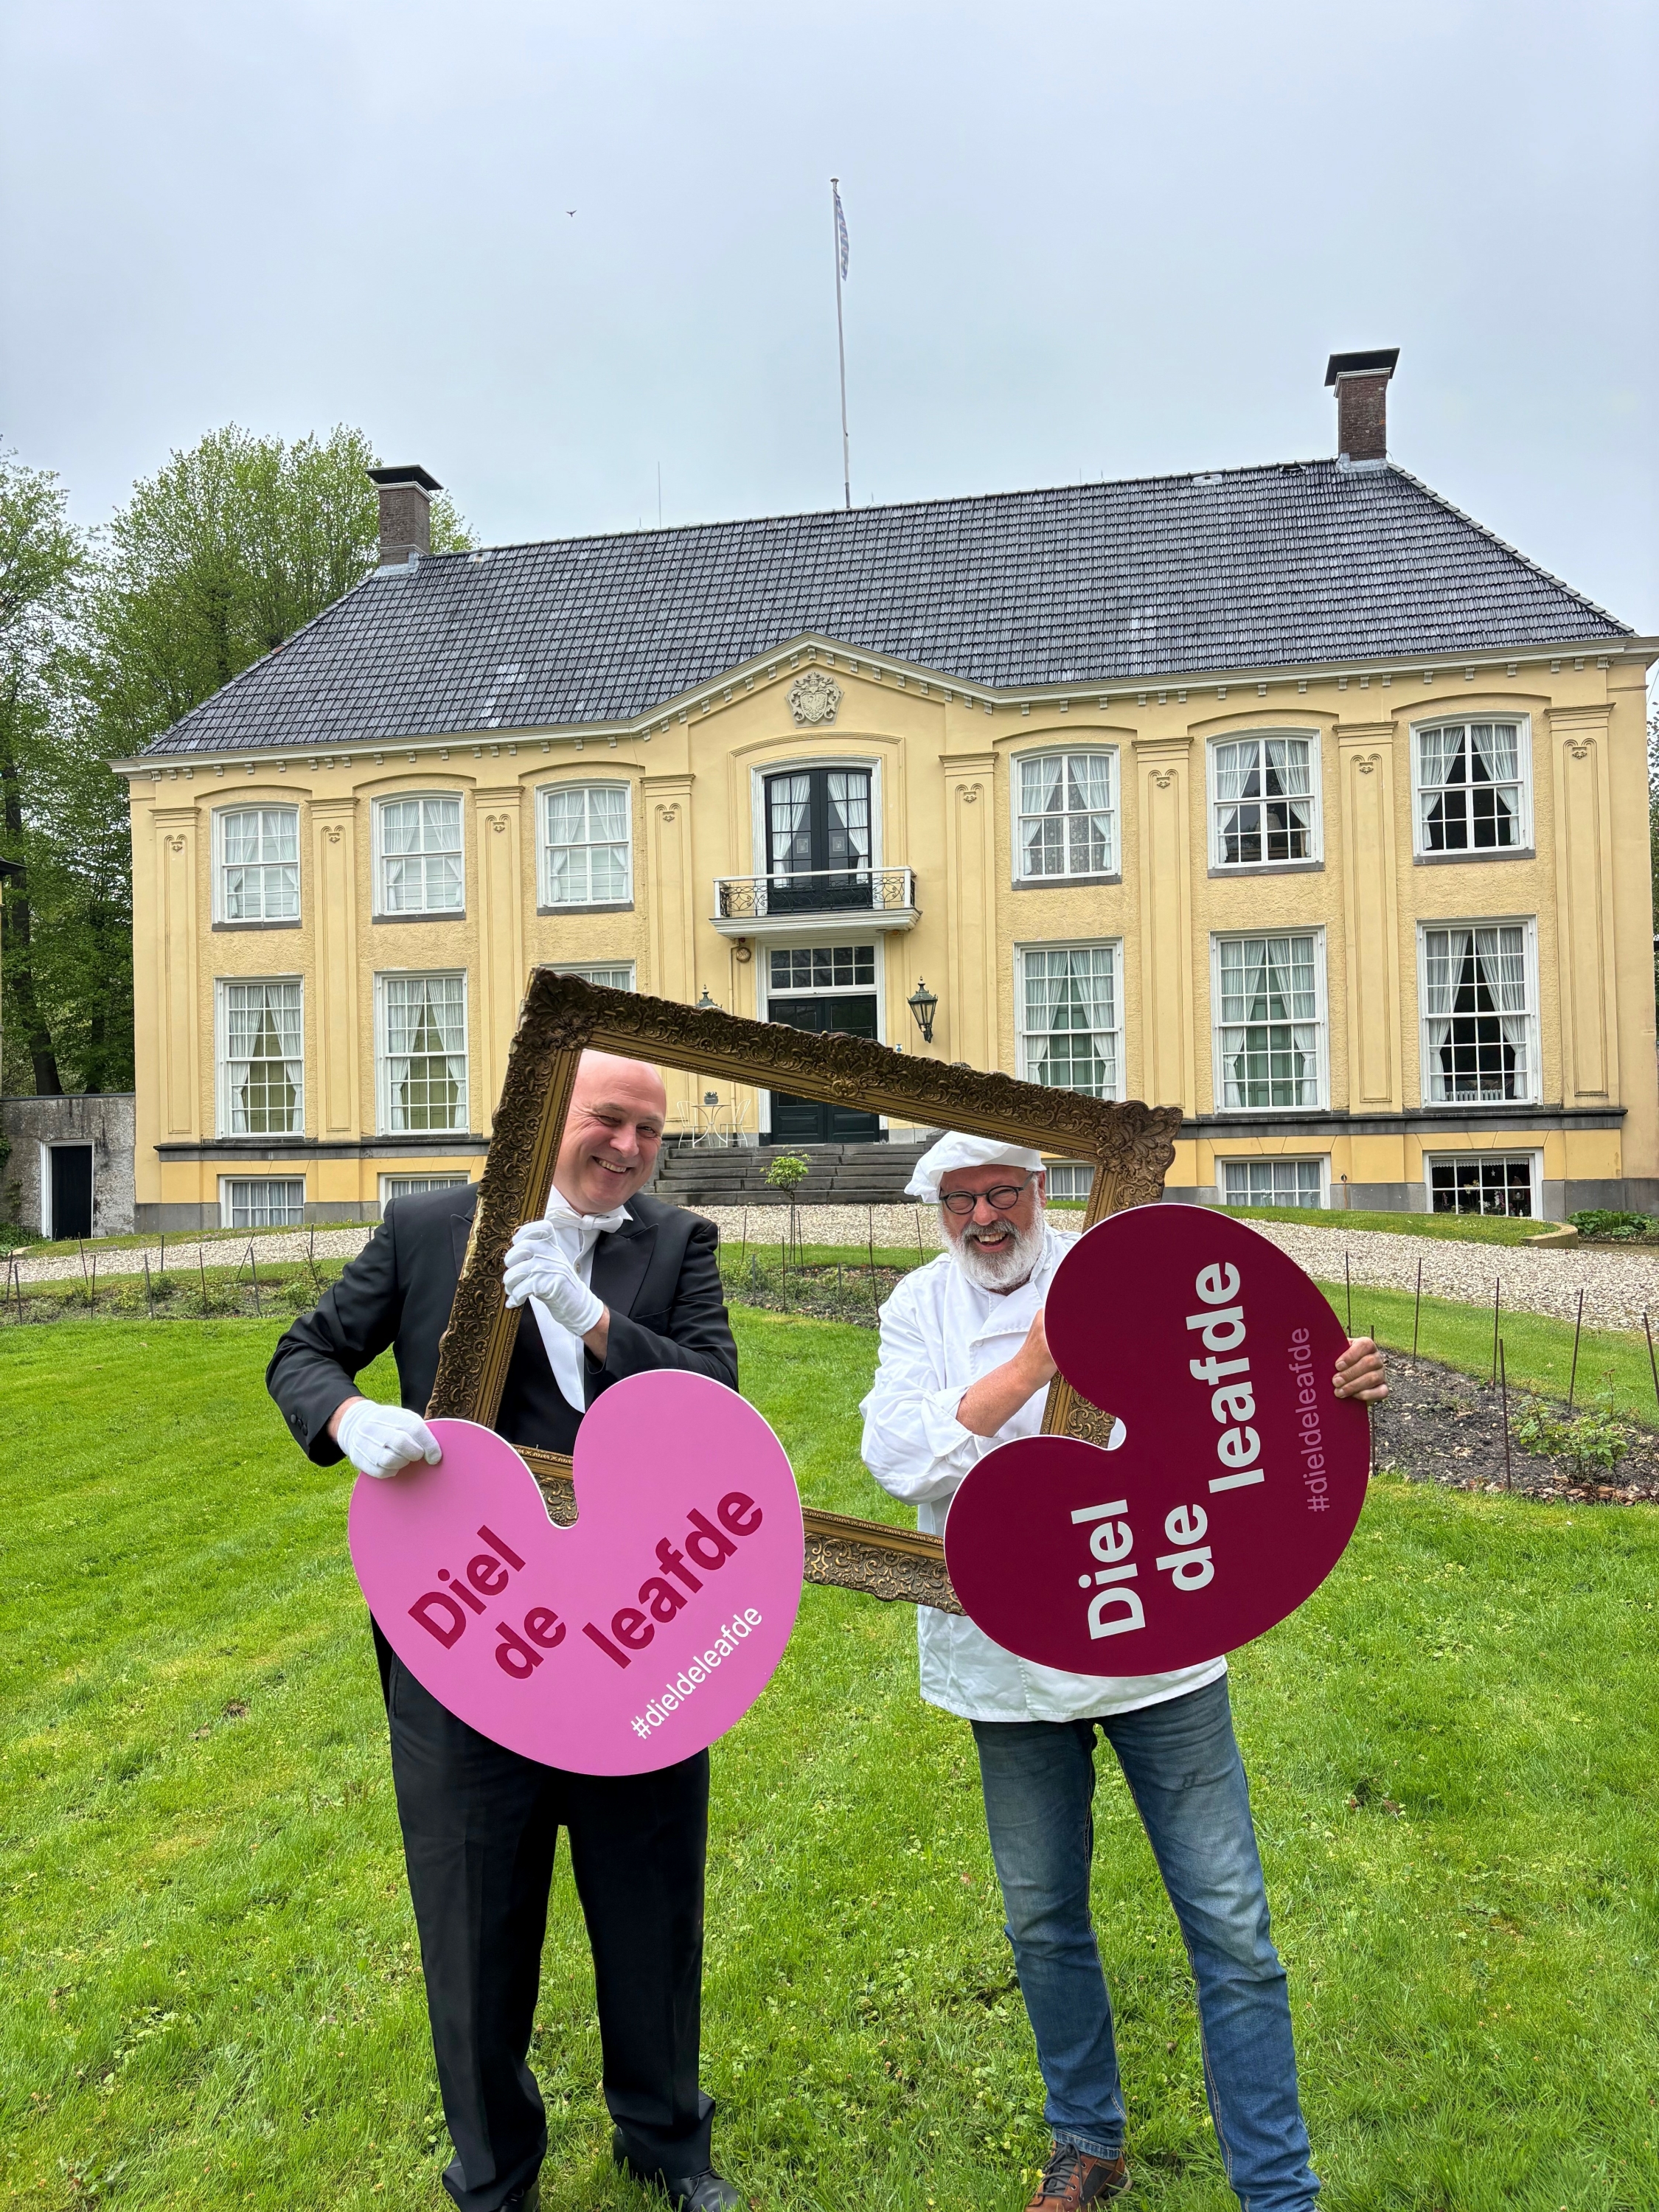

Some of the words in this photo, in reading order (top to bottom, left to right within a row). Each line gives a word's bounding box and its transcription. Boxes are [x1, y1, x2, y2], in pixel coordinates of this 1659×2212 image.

[1186, 1262, 1265, 1494] leafde
[1287, 1328, 1330, 1512] #dieldeleafde
[407, 1524, 526, 1650] Diel
[582, 1492, 763, 1669] leafde
[1071, 1499, 1146, 1640] Diel
[1156, 1503, 1215, 1591] de
[495, 1607, 567, 1680] de
[630, 1607, 762, 1740] #dieldeleafde
